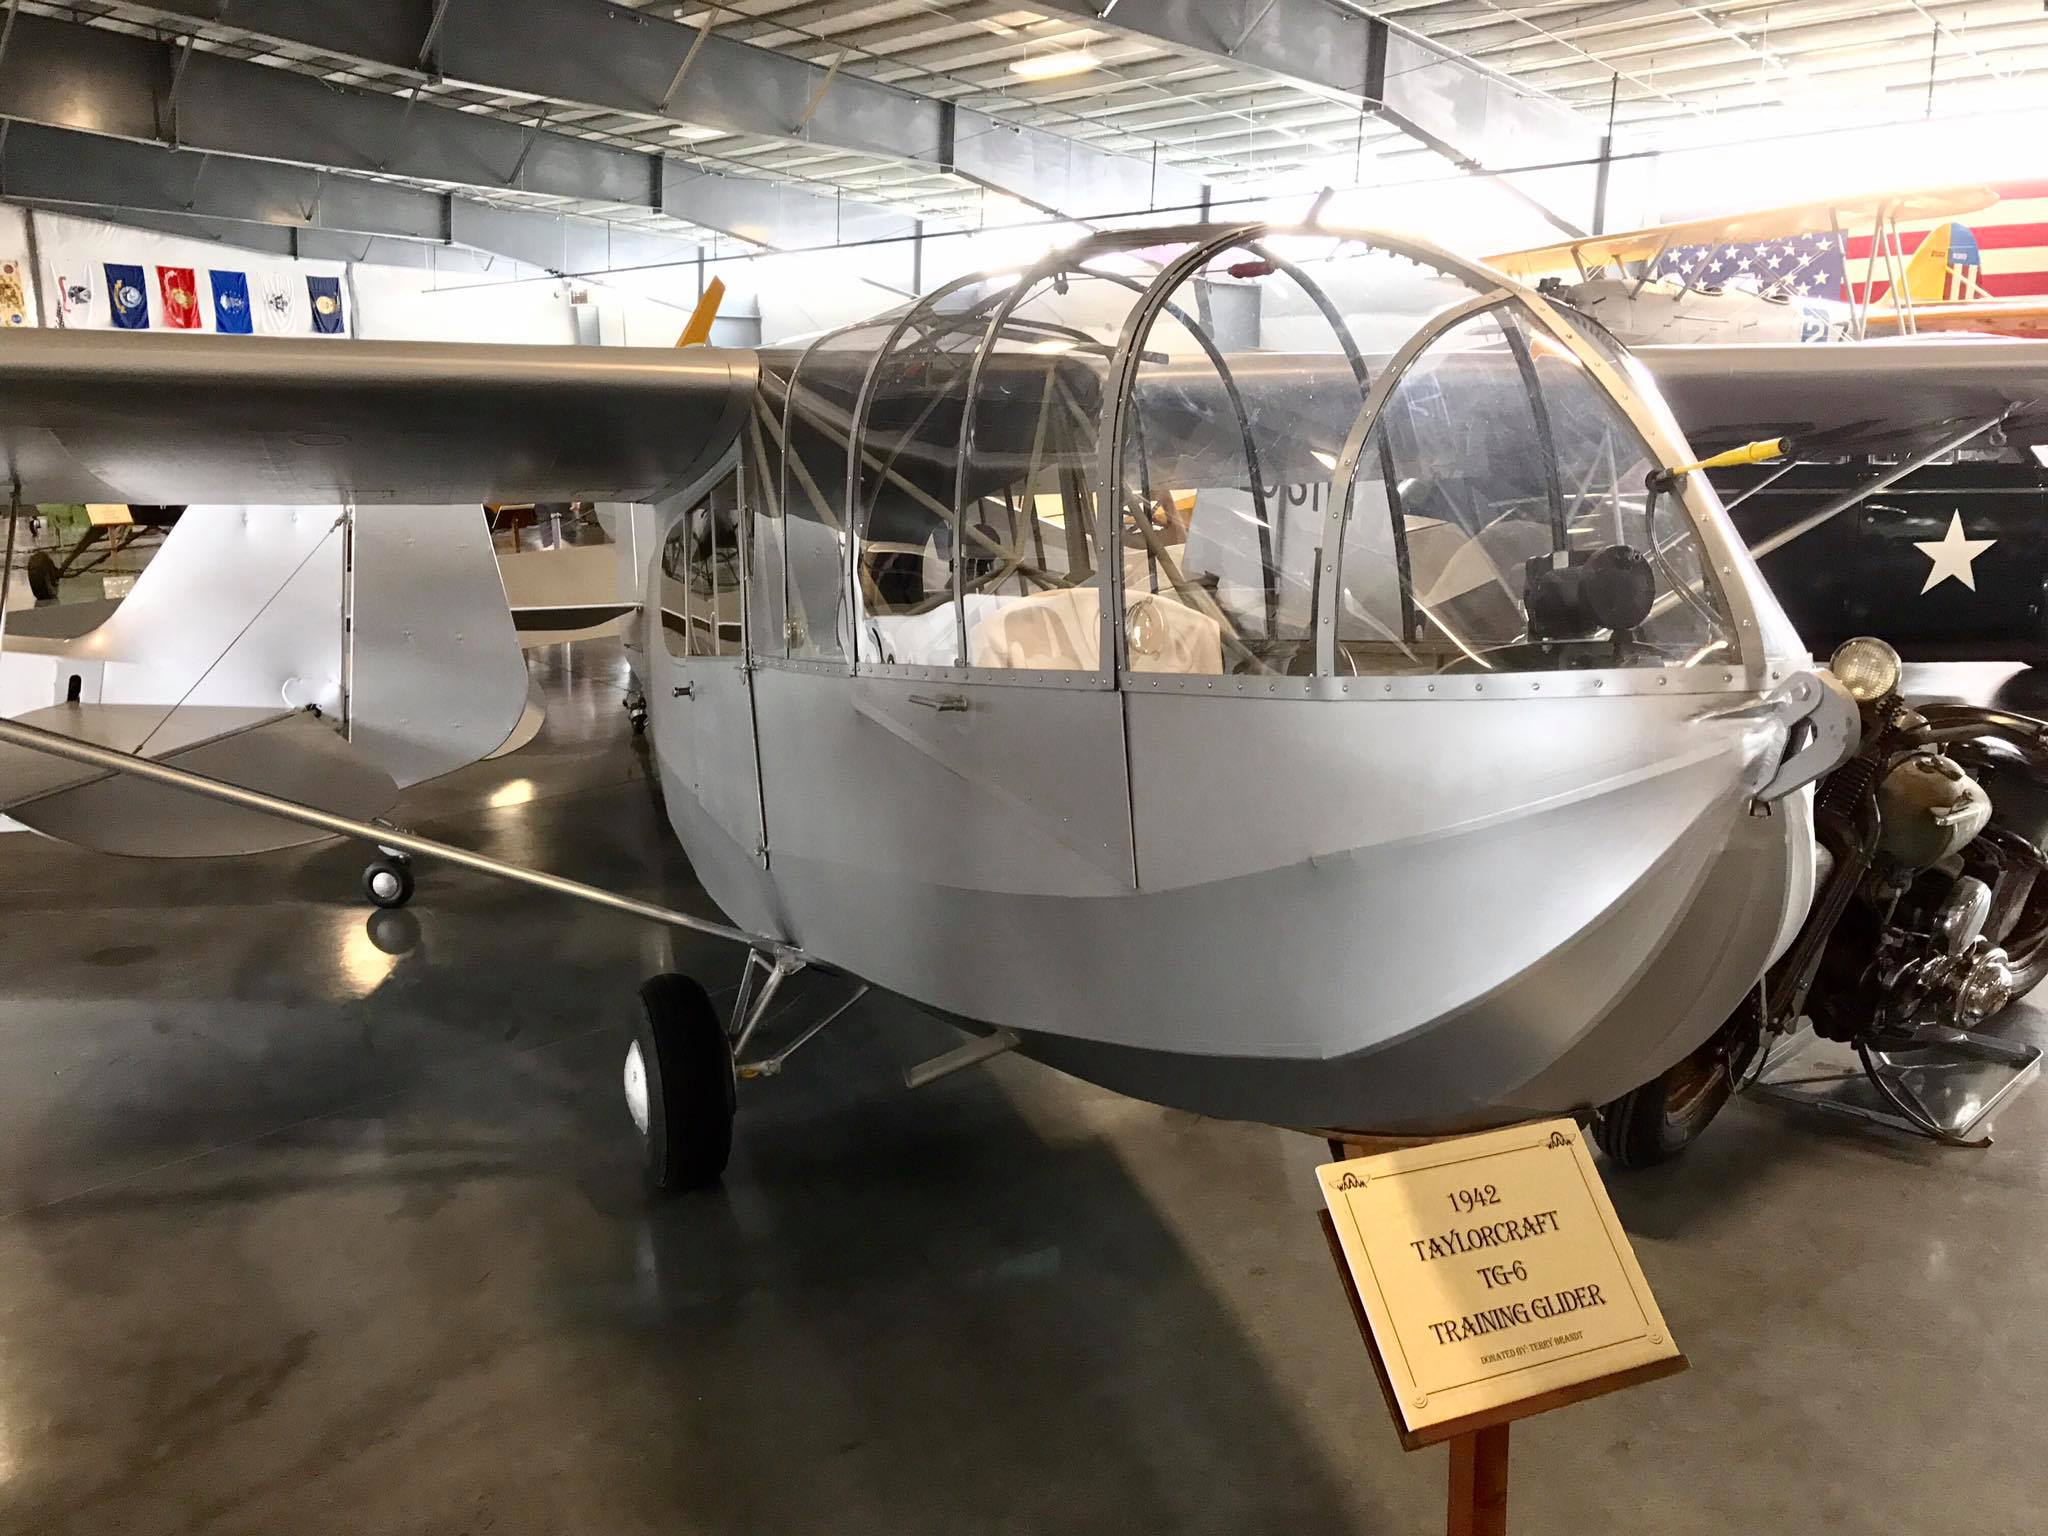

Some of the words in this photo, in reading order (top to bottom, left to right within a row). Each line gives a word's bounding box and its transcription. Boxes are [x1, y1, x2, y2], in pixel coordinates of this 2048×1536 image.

[1447, 1184, 1501, 1213] 1942
[1410, 1210, 1560, 1262] TAYLORCRAFT
[1477, 1260, 1528, 1289] TG-6
[1429, 1303, 1532, 1345] TRAINING
[1531, 1284, 1607, 1319] GLIDER
[1480, 1348, 1516, 1365] DONATED
[1529, 1337, 1553, 1352] TERRY
[1553, 1330, 1584, 1346] BRANDT
